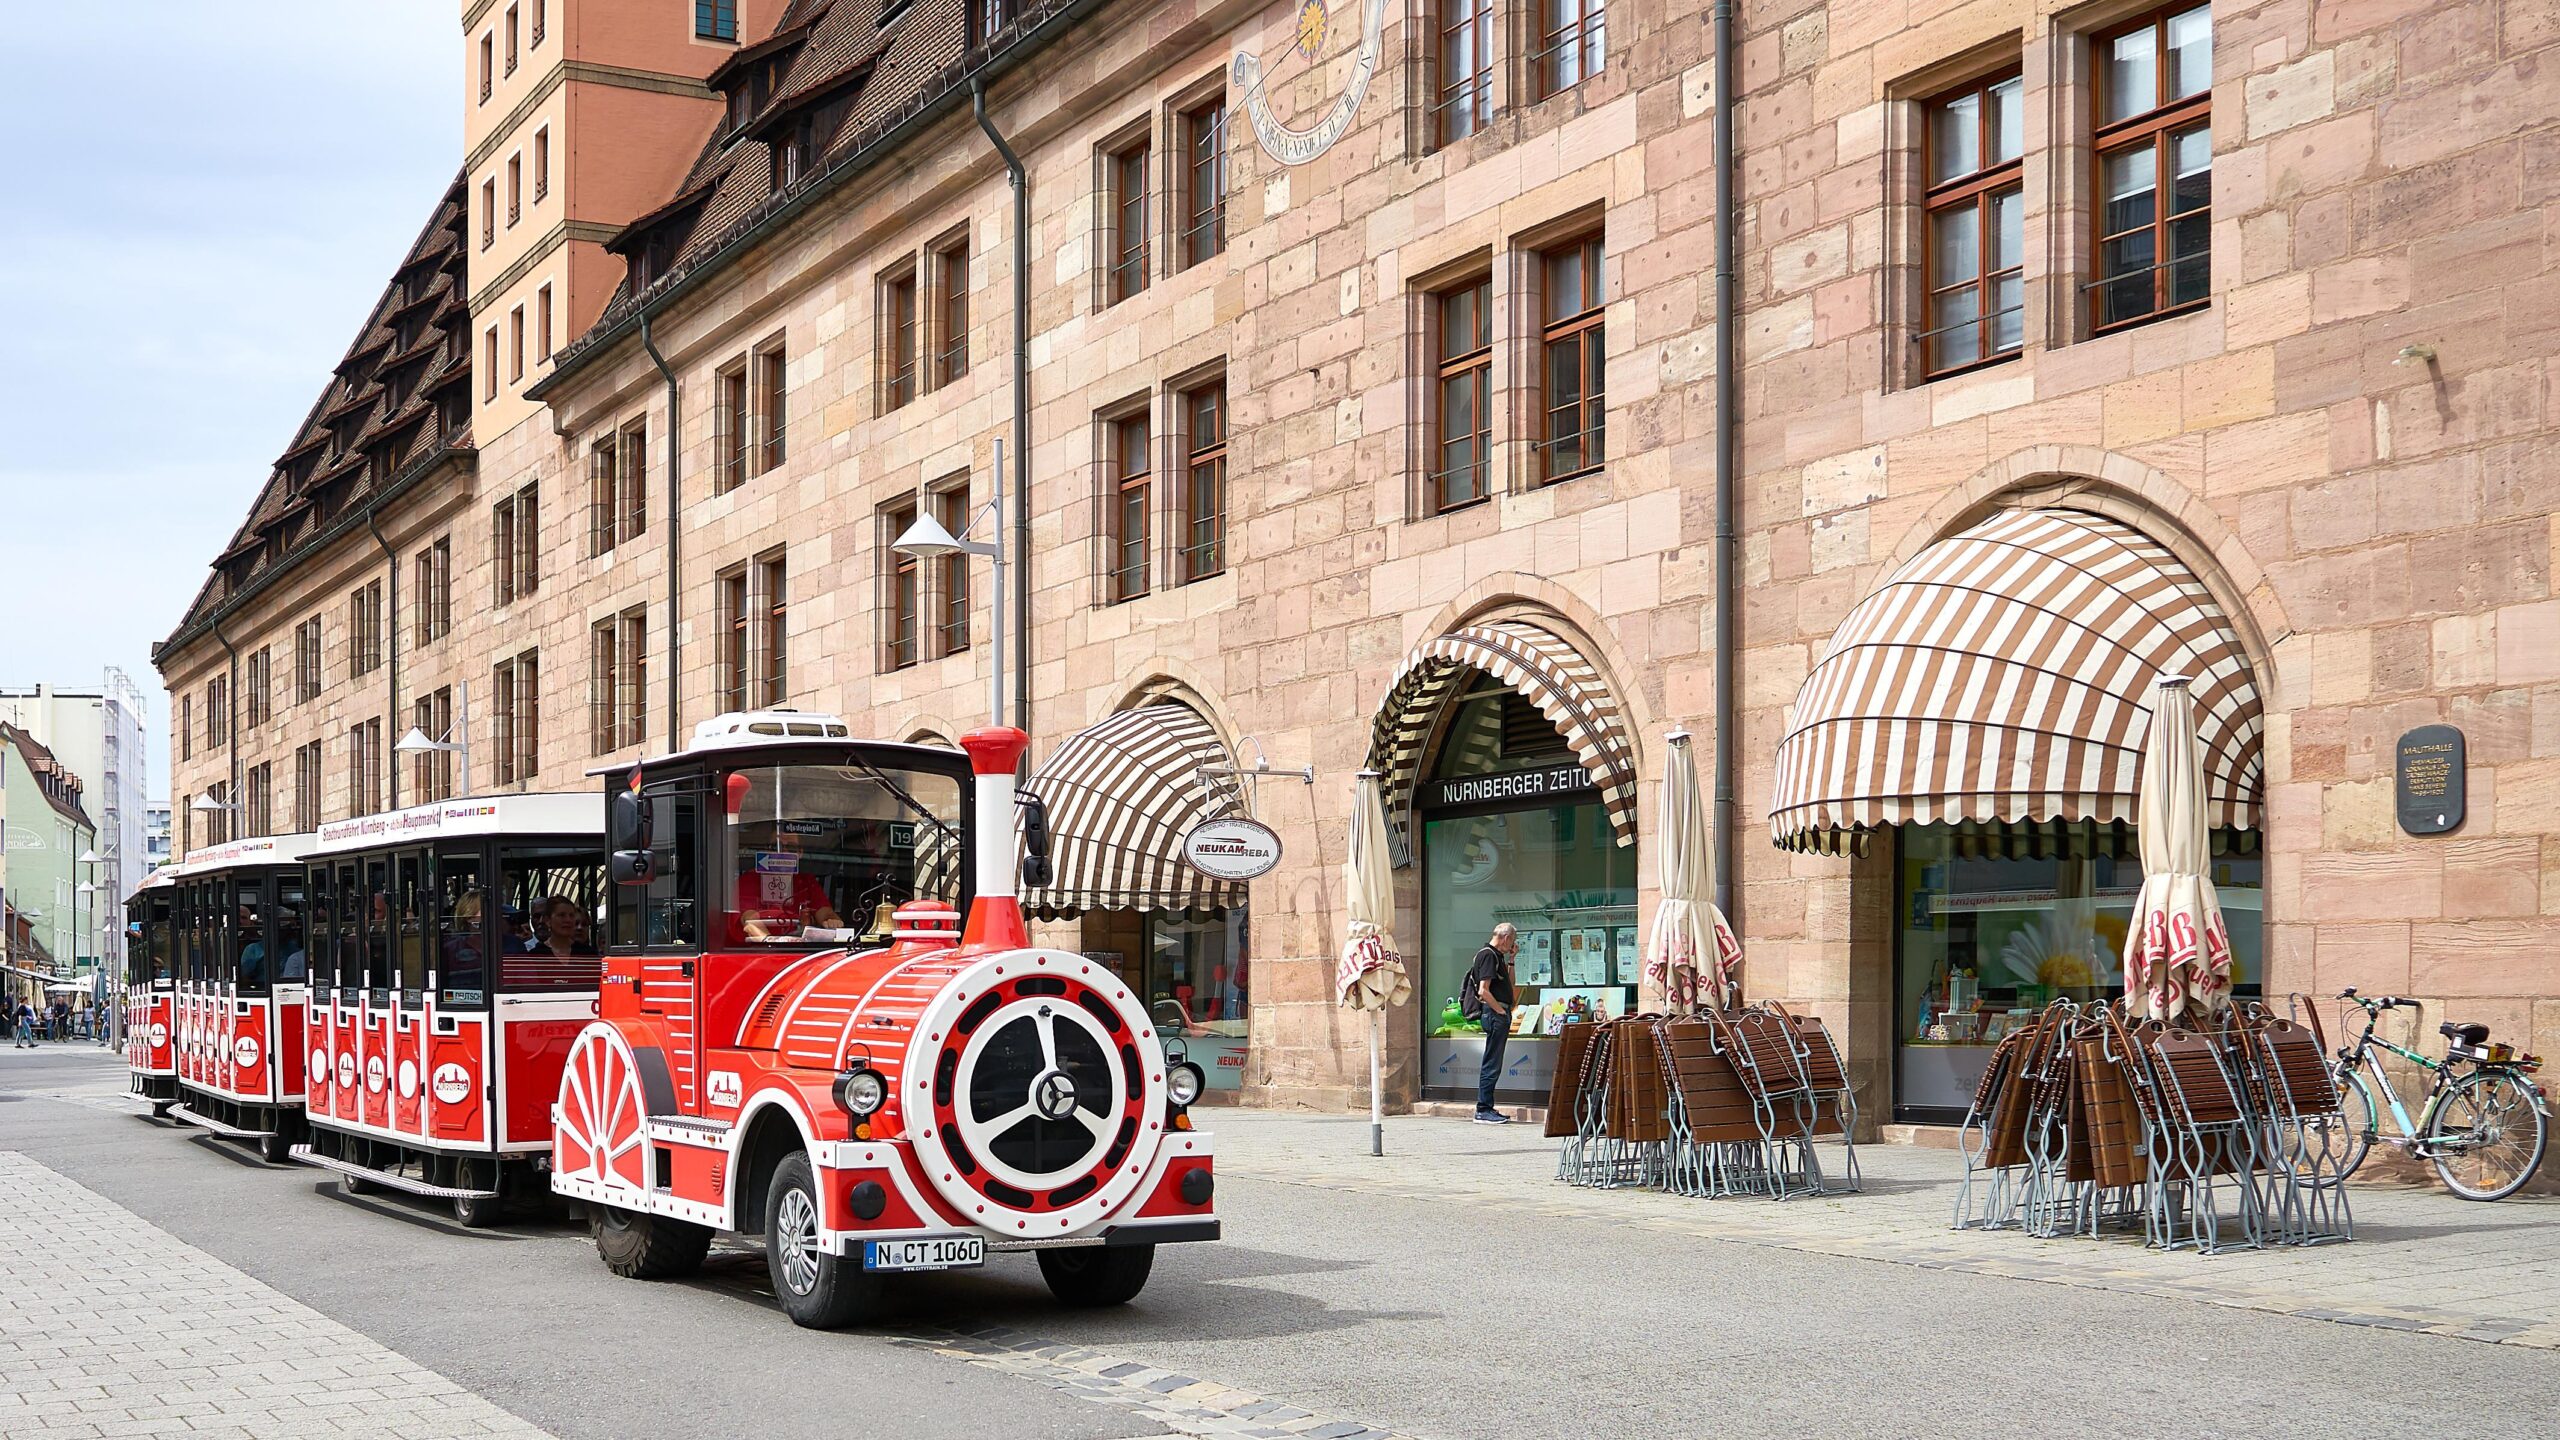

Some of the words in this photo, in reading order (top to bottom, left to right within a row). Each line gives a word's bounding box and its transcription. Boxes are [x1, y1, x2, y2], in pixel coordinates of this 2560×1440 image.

[2403, 743, 2453, 755] MAUTHALLE
[1443, 773, 1543, 803] NÜRNBERGER
[1550, 768, 1593, 791] ZEITU
[322, 824, 360, 842] Stadtrundfahrt
[360, 819, 386, 836] Nürnberg
[402, 808, 440, 832] Hauptmarkt
[1245, 824, 1265, 836] AGENCY
[1196, 844, 1244, 853] NEUKAM
[1241, 849, 1269, 857] REBA
[1195, 858, 1242, 876] STADTRUNDFAHRTEN
[1245, 868, 1256, 876] CITY
[455, 992, 481, 1001] DEUTSCH
[1217, 1056, 1244, 1066] NEUKA
[878, 1244, 891, 1264] N
[904, 1243, 928, 1263] CT
[933, 1241, 980, 1262] 1060
